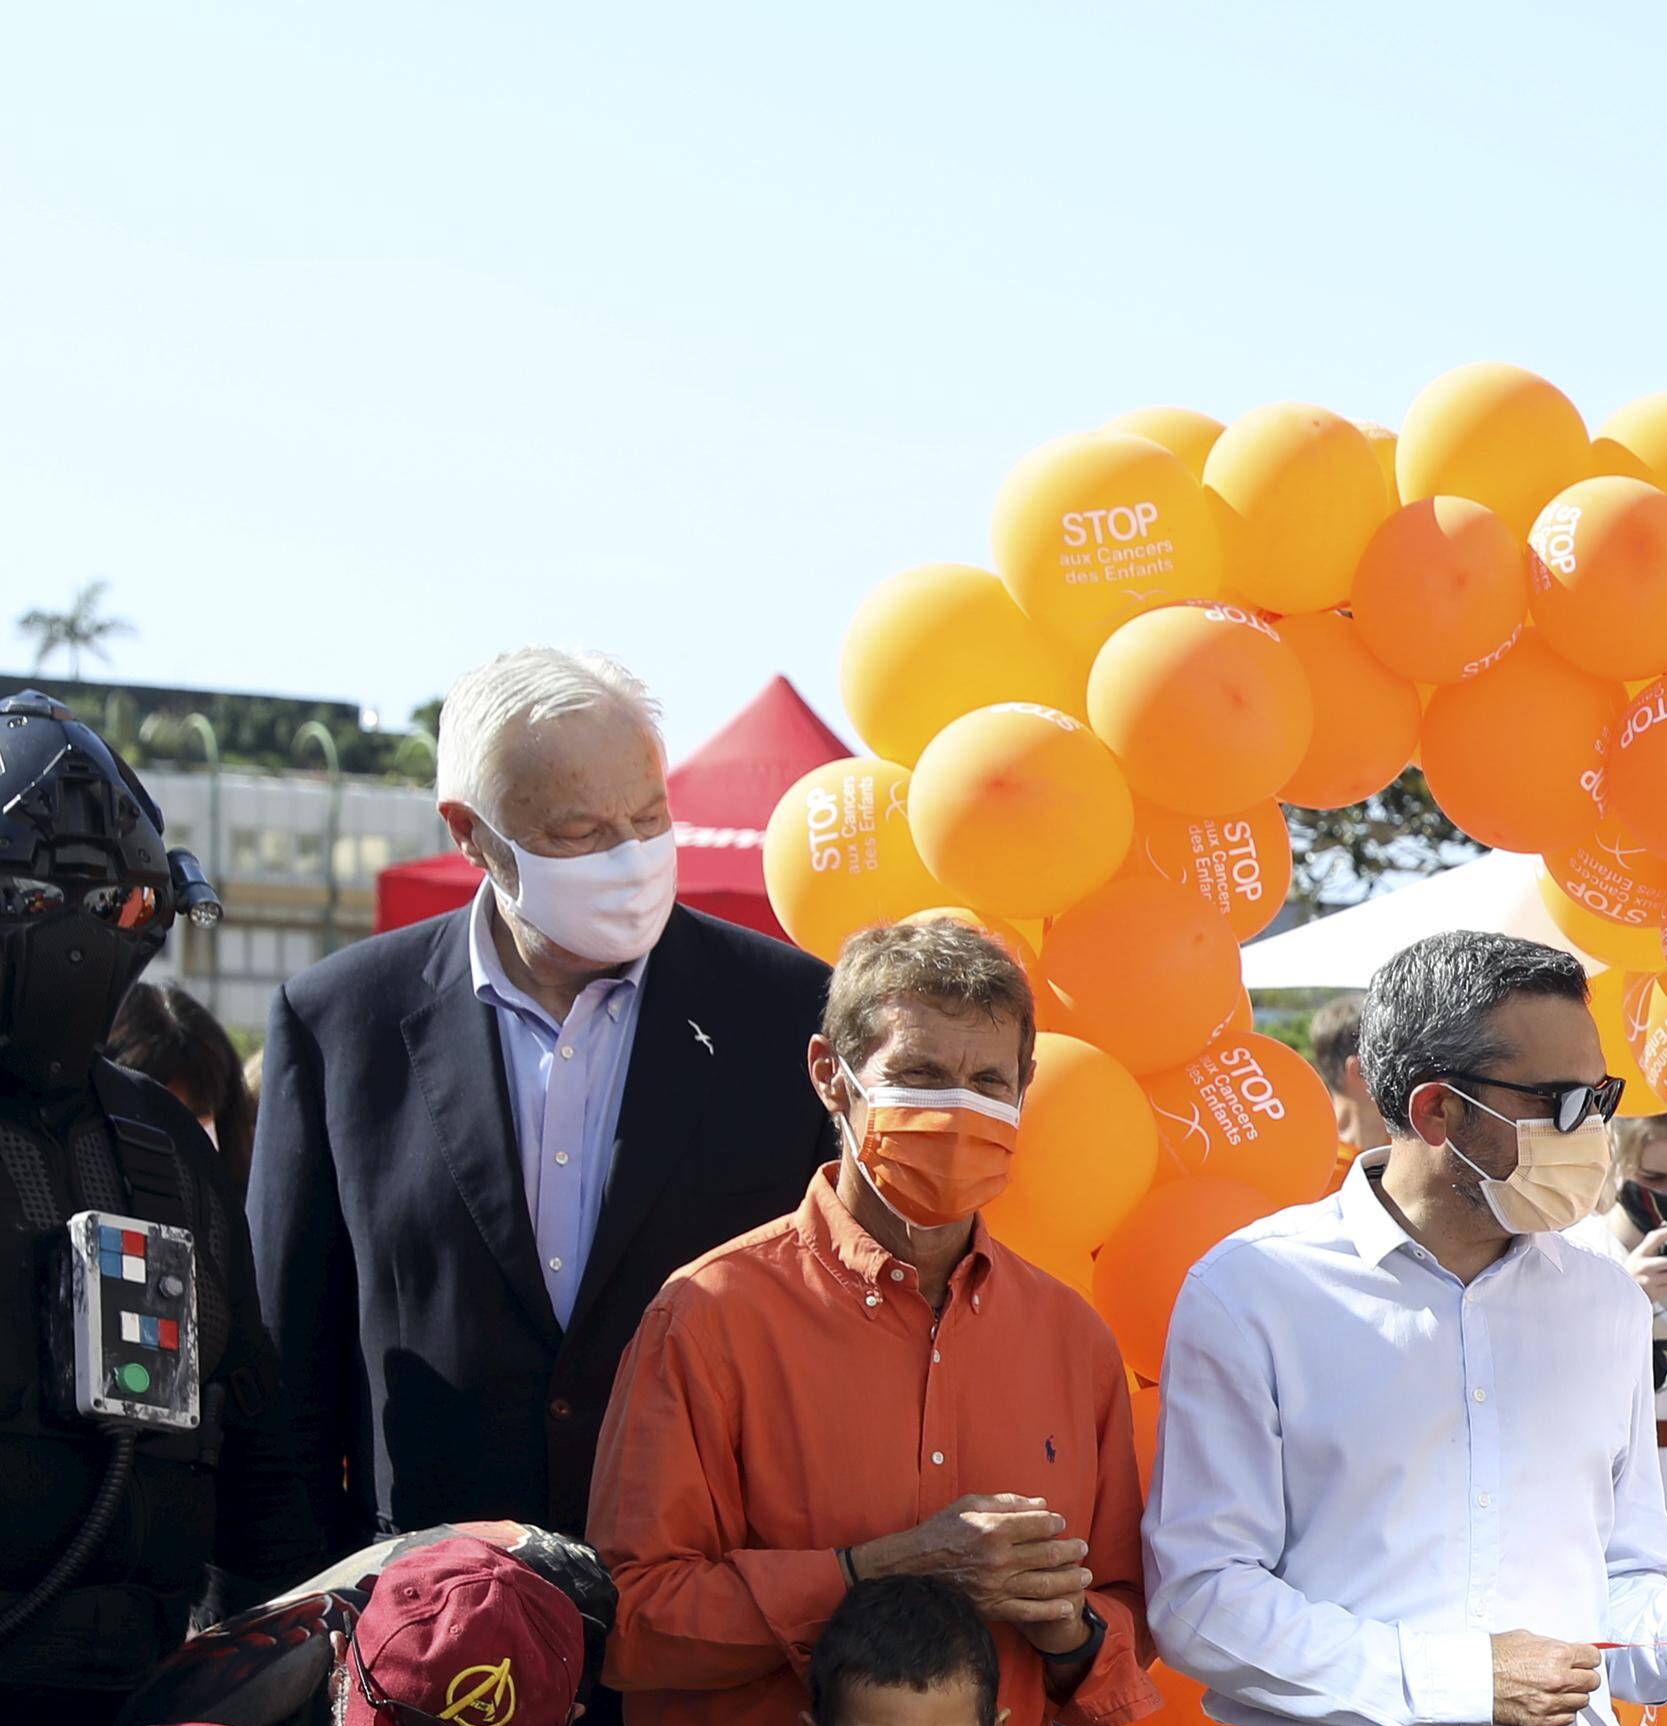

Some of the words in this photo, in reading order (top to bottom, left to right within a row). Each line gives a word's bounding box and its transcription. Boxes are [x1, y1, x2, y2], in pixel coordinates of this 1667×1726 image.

[1062, 501, 1158, 547] STOP
[1550, 504, 1583, 574] STOP
[1059, 553, 1092, 566] aux
[1097, 539, 1174, 564] Cancers
[1065, 570, 1099, 584] des
[1104, 558, 1174, 582] Enfants
[840, 776, 857, 838] Cancers
[858, 775, 876, 832] Enfants
[806, 787, 841, 872] STOP
[1188, 824, 1204, 854] des
[1203, 819, 1220, 848] aux
[864, 837, 878, 870] des
[1223, 820, 1263, 901] STOP
[1577, 848, 1634, 892] Enfants
[1195, 857, 1213, 901] Enfa
[1211, 851, 1231, 914] Cancers
[1566, 880, 1647, 925] STOP
[1568, 856, 1631, 903] Cancers
[1214, 1074, 1259, 1141] Cancers
[1220, 1048, 1285, 1121] STOP
[1200, 1081, 1242, 1147] Enfants
